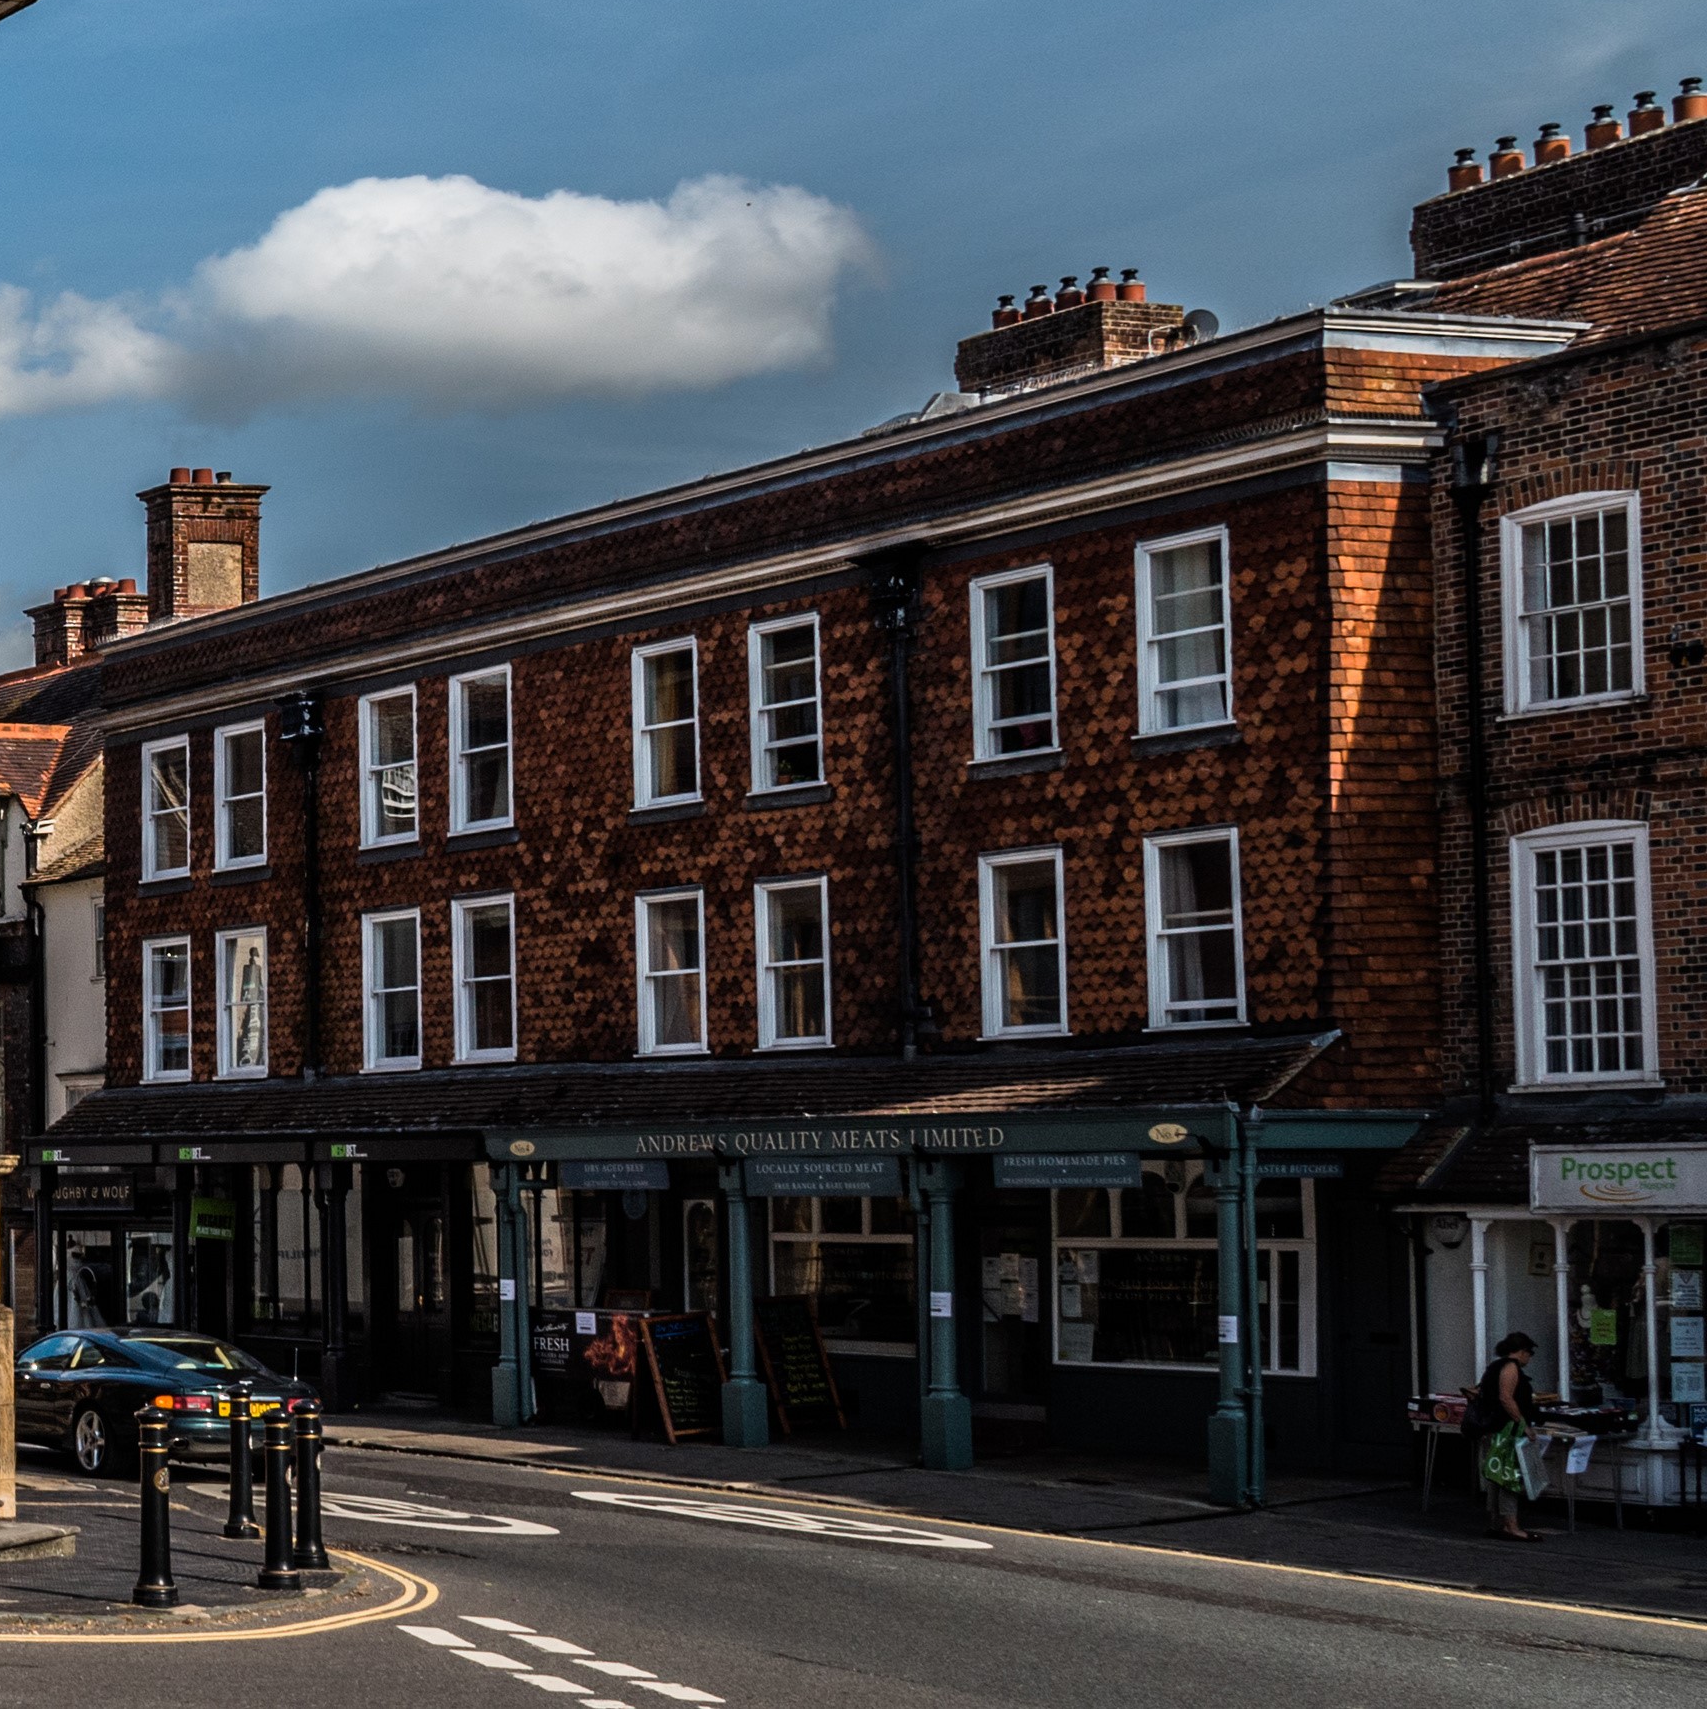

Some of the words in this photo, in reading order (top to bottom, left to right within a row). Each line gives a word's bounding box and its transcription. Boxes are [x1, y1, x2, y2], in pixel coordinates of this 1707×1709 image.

[637, 1133, 728, 1153] ANDREWS
[735, 1131, 823, 1153] QUALITY
[831, 1129, 901, 1150] MEATS
[755, 1164, 801, 1174] LOCALLY
[804, 1163, 852, 1174] SOURCED
[855, 1162, 884, 1173] MEAT
[1003, 1157, 1035, 1167] FRESH
[1038, 1156, 1100, 1167] HOMEMADE
[1103, 1155, 1126, 1165] PIES
[1256, 1164, 1287, 1174] ASTER
[1289, 1164, 1339, 1174] BUTCHERS
[1561, 1157, 1678, 1186] Prospect
[102, 1186, 131, 1200] WOLF
[533, 1336, 570, 1351] FRESH
